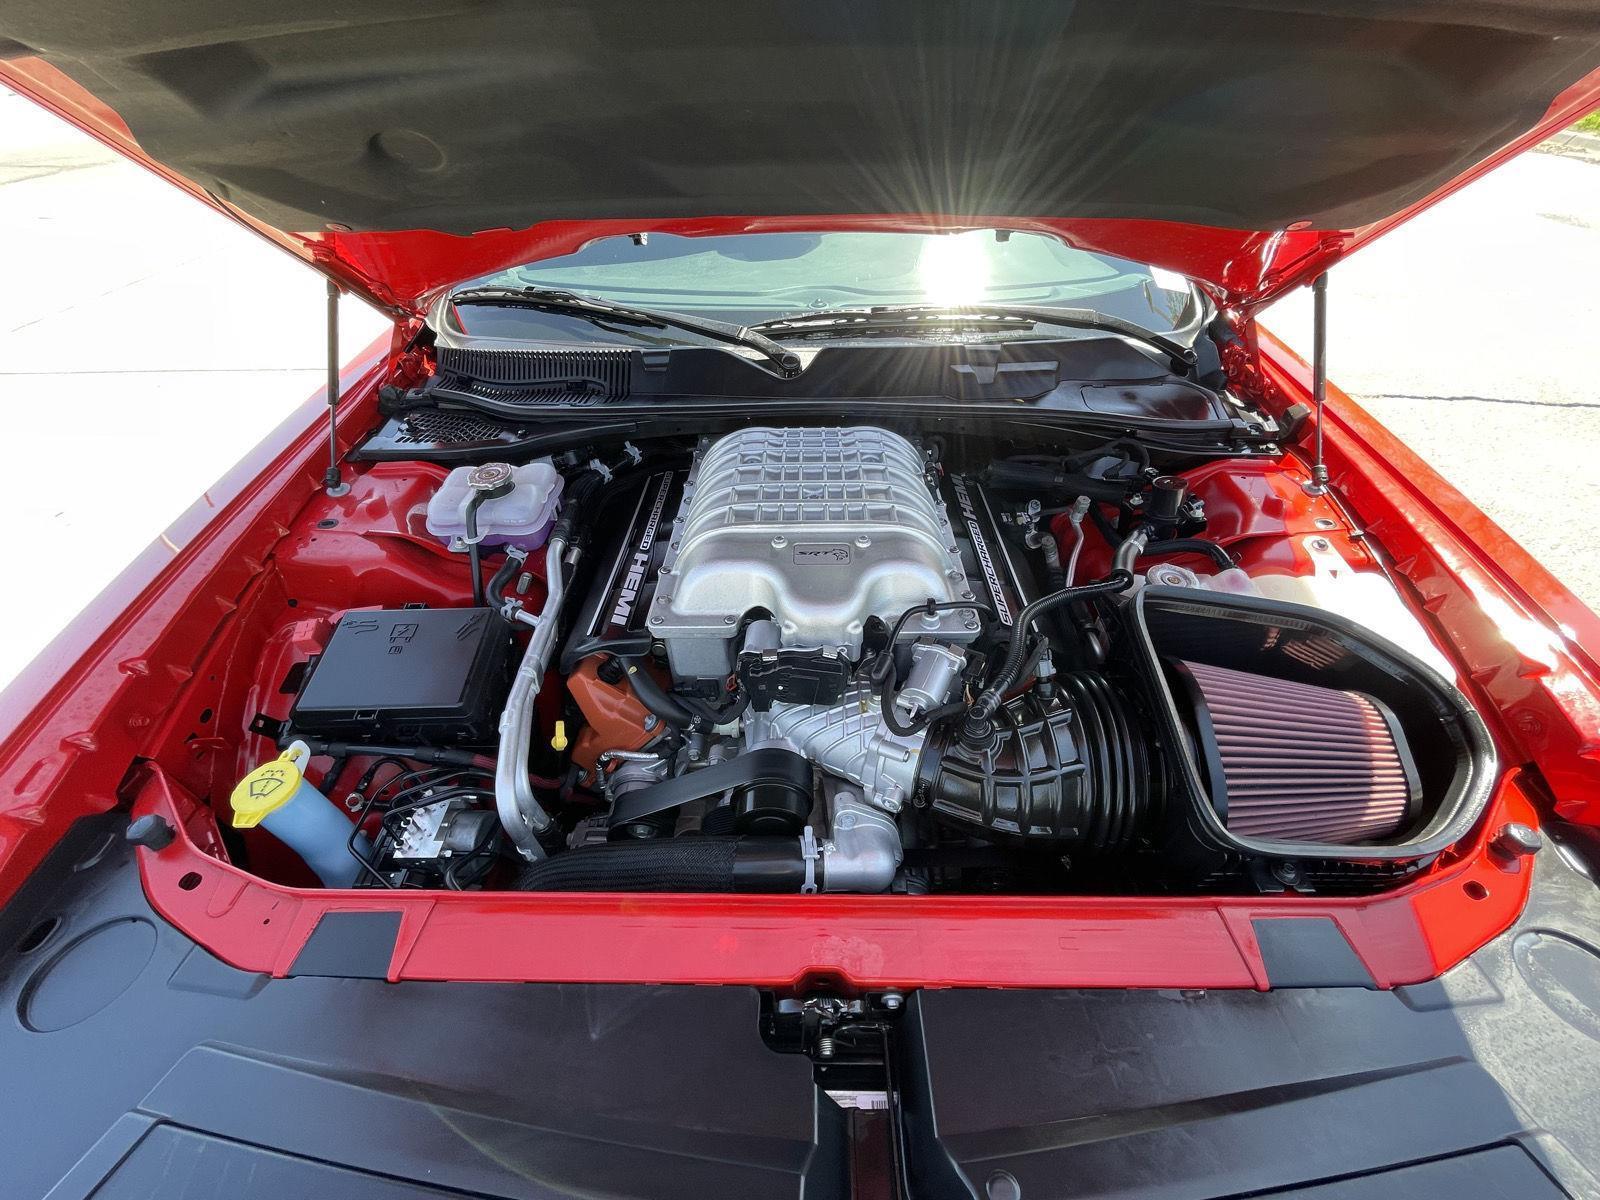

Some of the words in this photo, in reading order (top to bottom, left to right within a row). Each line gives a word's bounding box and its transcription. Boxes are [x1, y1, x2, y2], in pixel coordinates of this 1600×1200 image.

[641, 471, 673, 549] SUPERCHARGED
[950, 473, 977, 520] HEMI
[611, 553, 648, 625] HEMI
[968, 520, 1012, 626] SUPERCHARGED
